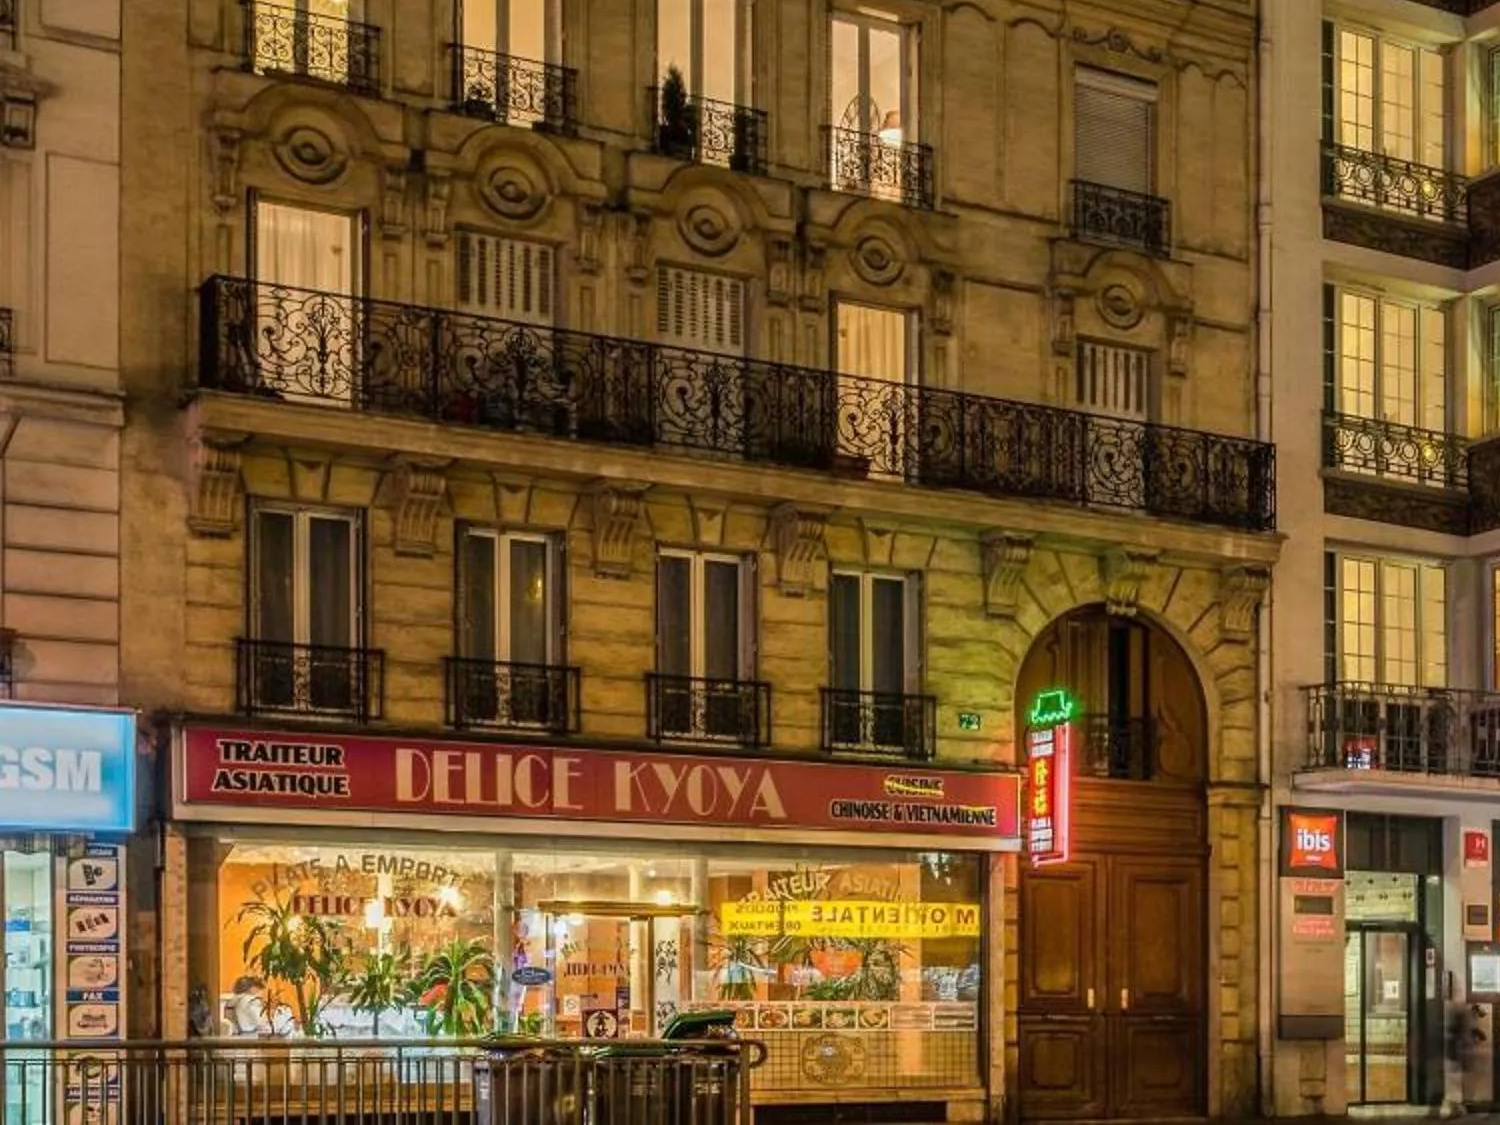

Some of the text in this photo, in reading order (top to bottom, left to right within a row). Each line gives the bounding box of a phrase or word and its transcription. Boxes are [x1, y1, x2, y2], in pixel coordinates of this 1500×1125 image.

[217, 739, 344, 767] TRAITEUR
[0, 745, 101, 793] GSM
[395, 748, 787, 818] DELICE KYOYA
[212, 769, 350, 799] ASIATIQUE
[831, 800, 889, 820] CHINOISE
[904, 804, 996, 826] VIETNAMIENNE
[1297, 828, 1330, 851] ibis
